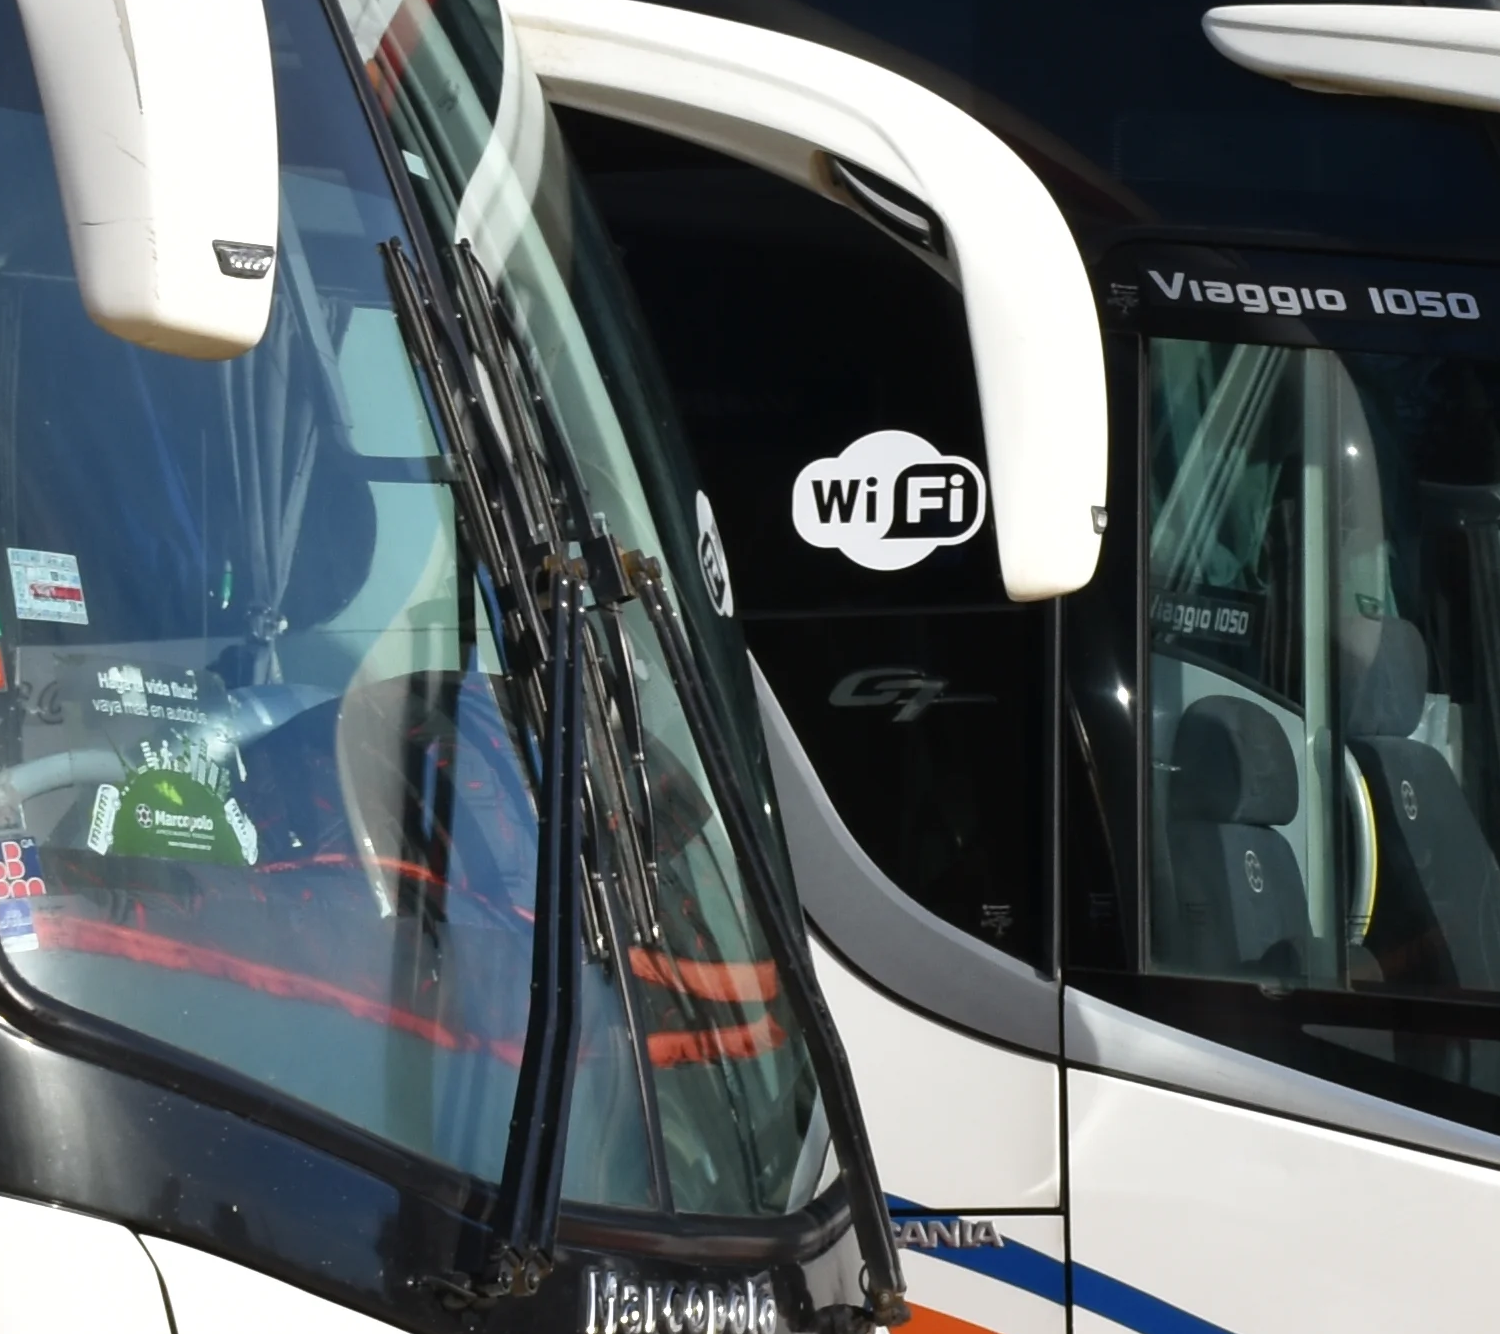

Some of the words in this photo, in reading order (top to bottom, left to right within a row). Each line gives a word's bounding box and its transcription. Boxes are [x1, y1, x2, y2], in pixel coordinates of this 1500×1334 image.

[1147, 270, 1348, 316] Viaggio
[1368, 286, 1481, 321] 1050
[155, 809, 214, 833] Marcopolo
